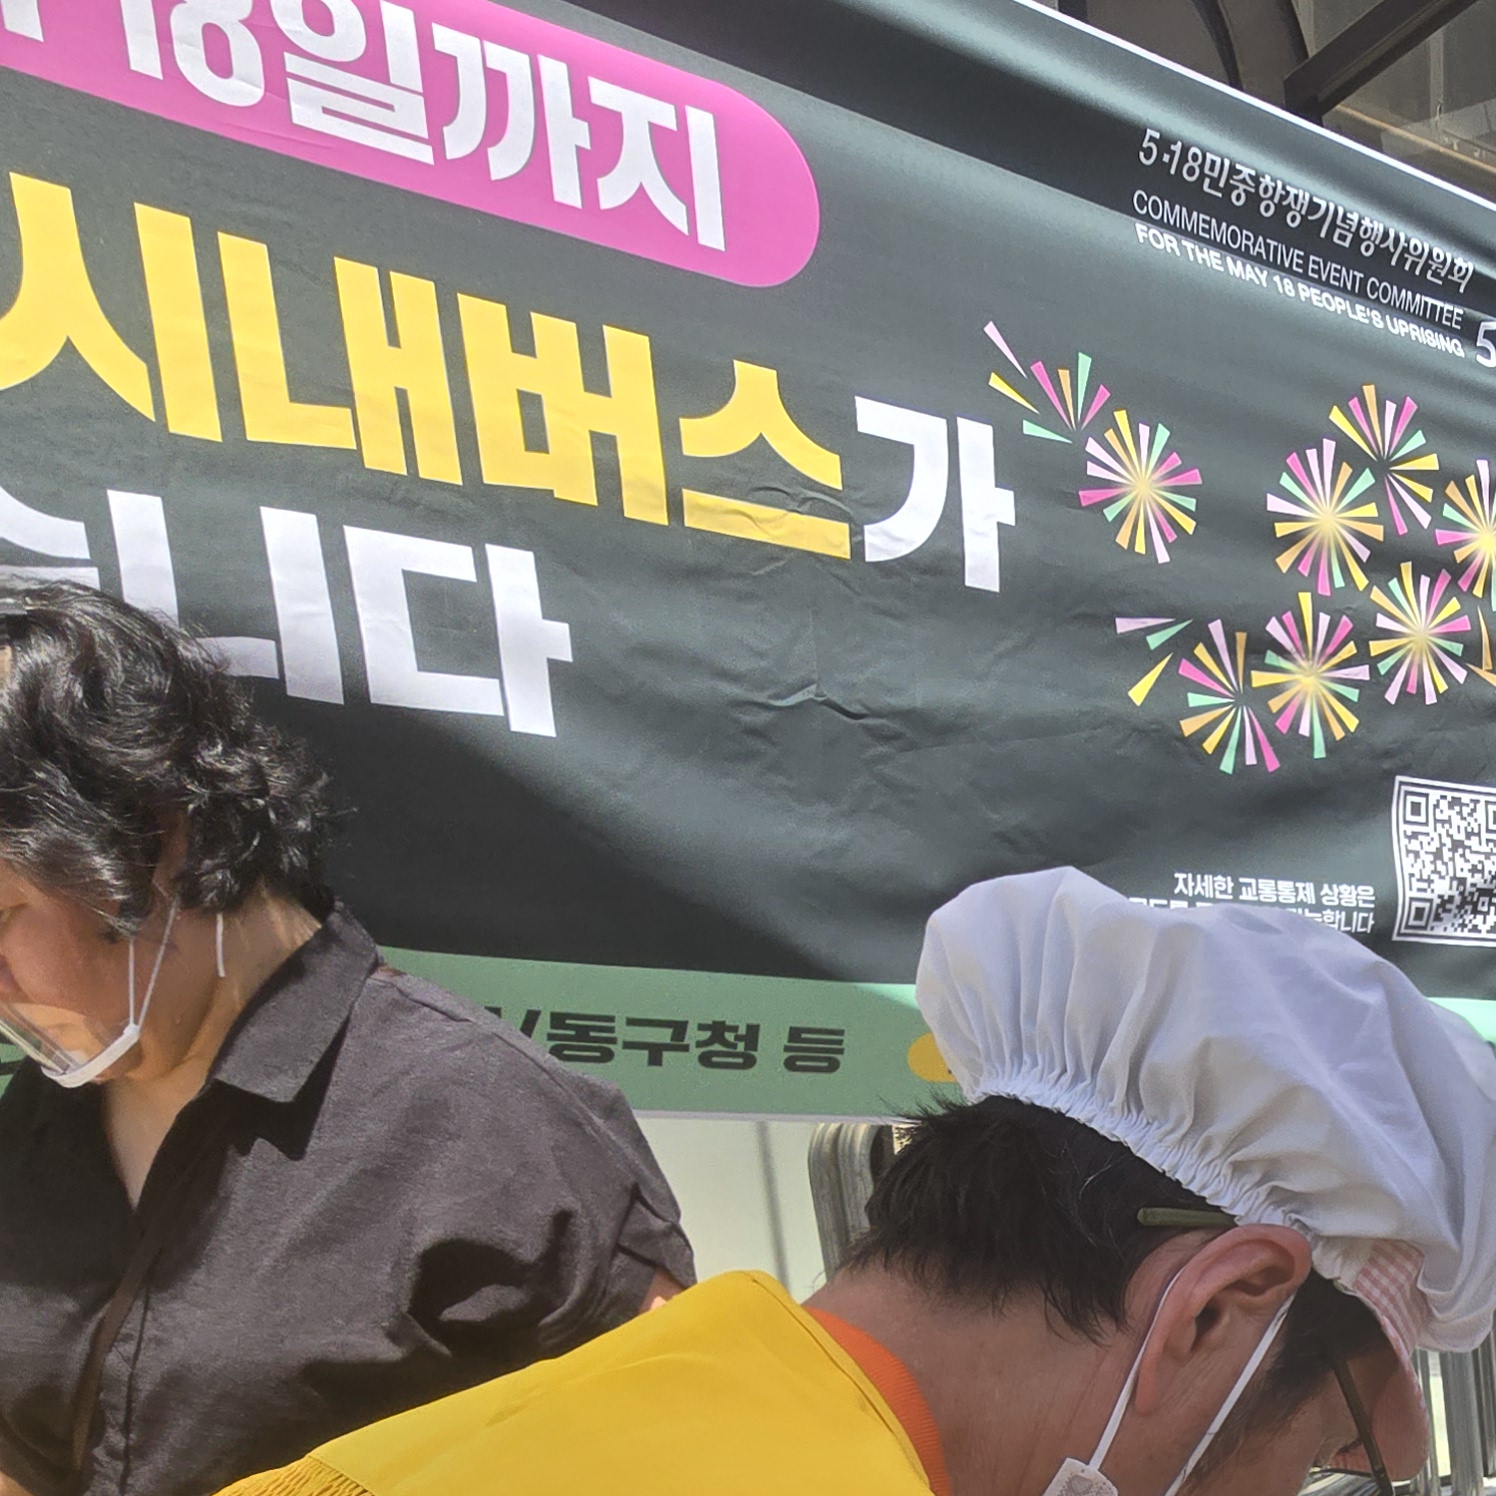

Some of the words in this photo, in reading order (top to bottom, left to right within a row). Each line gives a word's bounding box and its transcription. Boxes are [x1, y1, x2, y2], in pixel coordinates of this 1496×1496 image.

[1132, 189, 1305, 273] COMMEMORATIVE
[1308, 254, 1364, 294] EVENT
[1366, 276, 1464, 330] COMMITTEE
[1134, 222, 1180, 256] FOR
[1181, 239, 1225, 272] THE
[1226, 256, 1268, 288] MAY
[1272, 274, 1296, 298] 18
[1297, 282, 1385, 329] PEOPLE'S
[1385, 314, 1465, 359] UPRISING
[0, 172, 1016, 593] 시내버스가
[0, 485, 573, 737] 니다
[1173, 872, 1235, 901] 자세한
[1320, 884, 1376, 909] 상황은
[783, 1026, 846, 1074] 등
